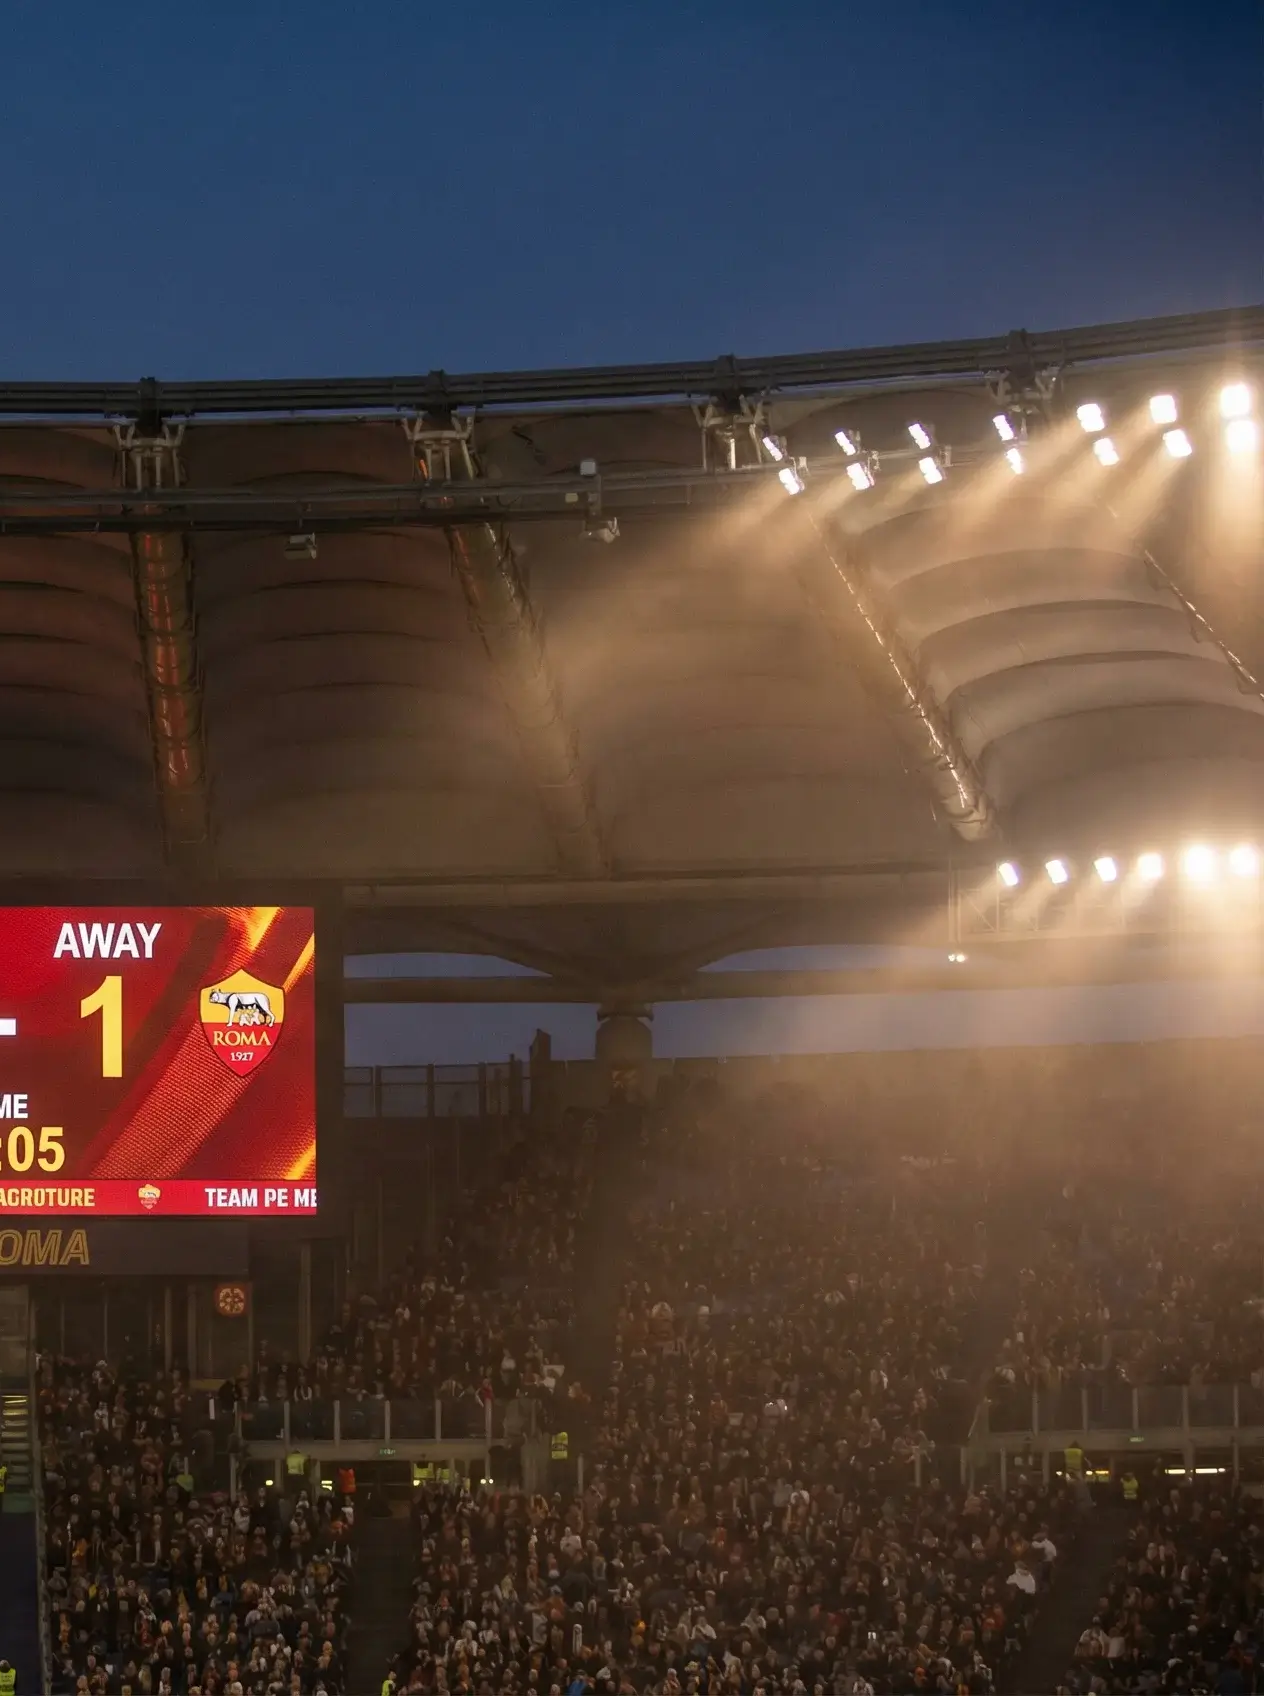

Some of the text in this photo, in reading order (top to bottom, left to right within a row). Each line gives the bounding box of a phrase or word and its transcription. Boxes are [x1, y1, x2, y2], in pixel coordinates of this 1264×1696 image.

[53, 922, 162, 959] AWAY
[80, 975, 123, 1078] 1
[213, 1030, 272, 1046] ROMA
[204, 1187, 258, 1208] TEAM
[264, 1188, 289, 1208] PE
